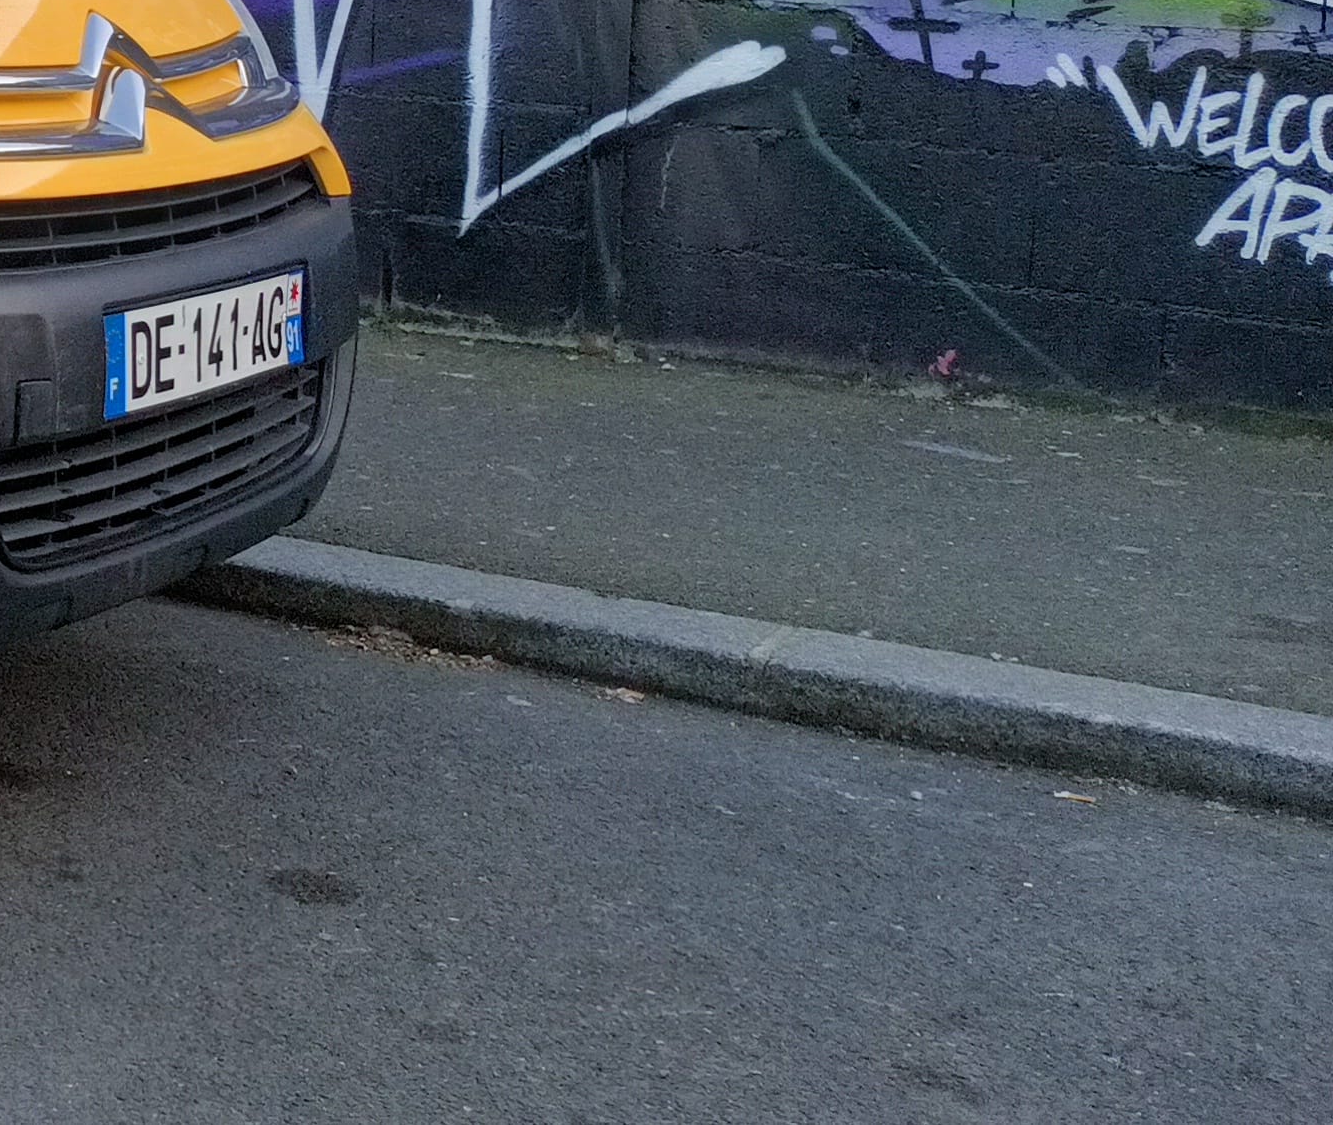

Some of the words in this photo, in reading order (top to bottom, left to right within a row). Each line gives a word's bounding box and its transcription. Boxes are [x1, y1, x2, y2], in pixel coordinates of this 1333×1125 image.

[130, 285, 284, 401] DE-141-AG
[286, 319, 301, 354] 91
[109, 377, 120, 402] F
